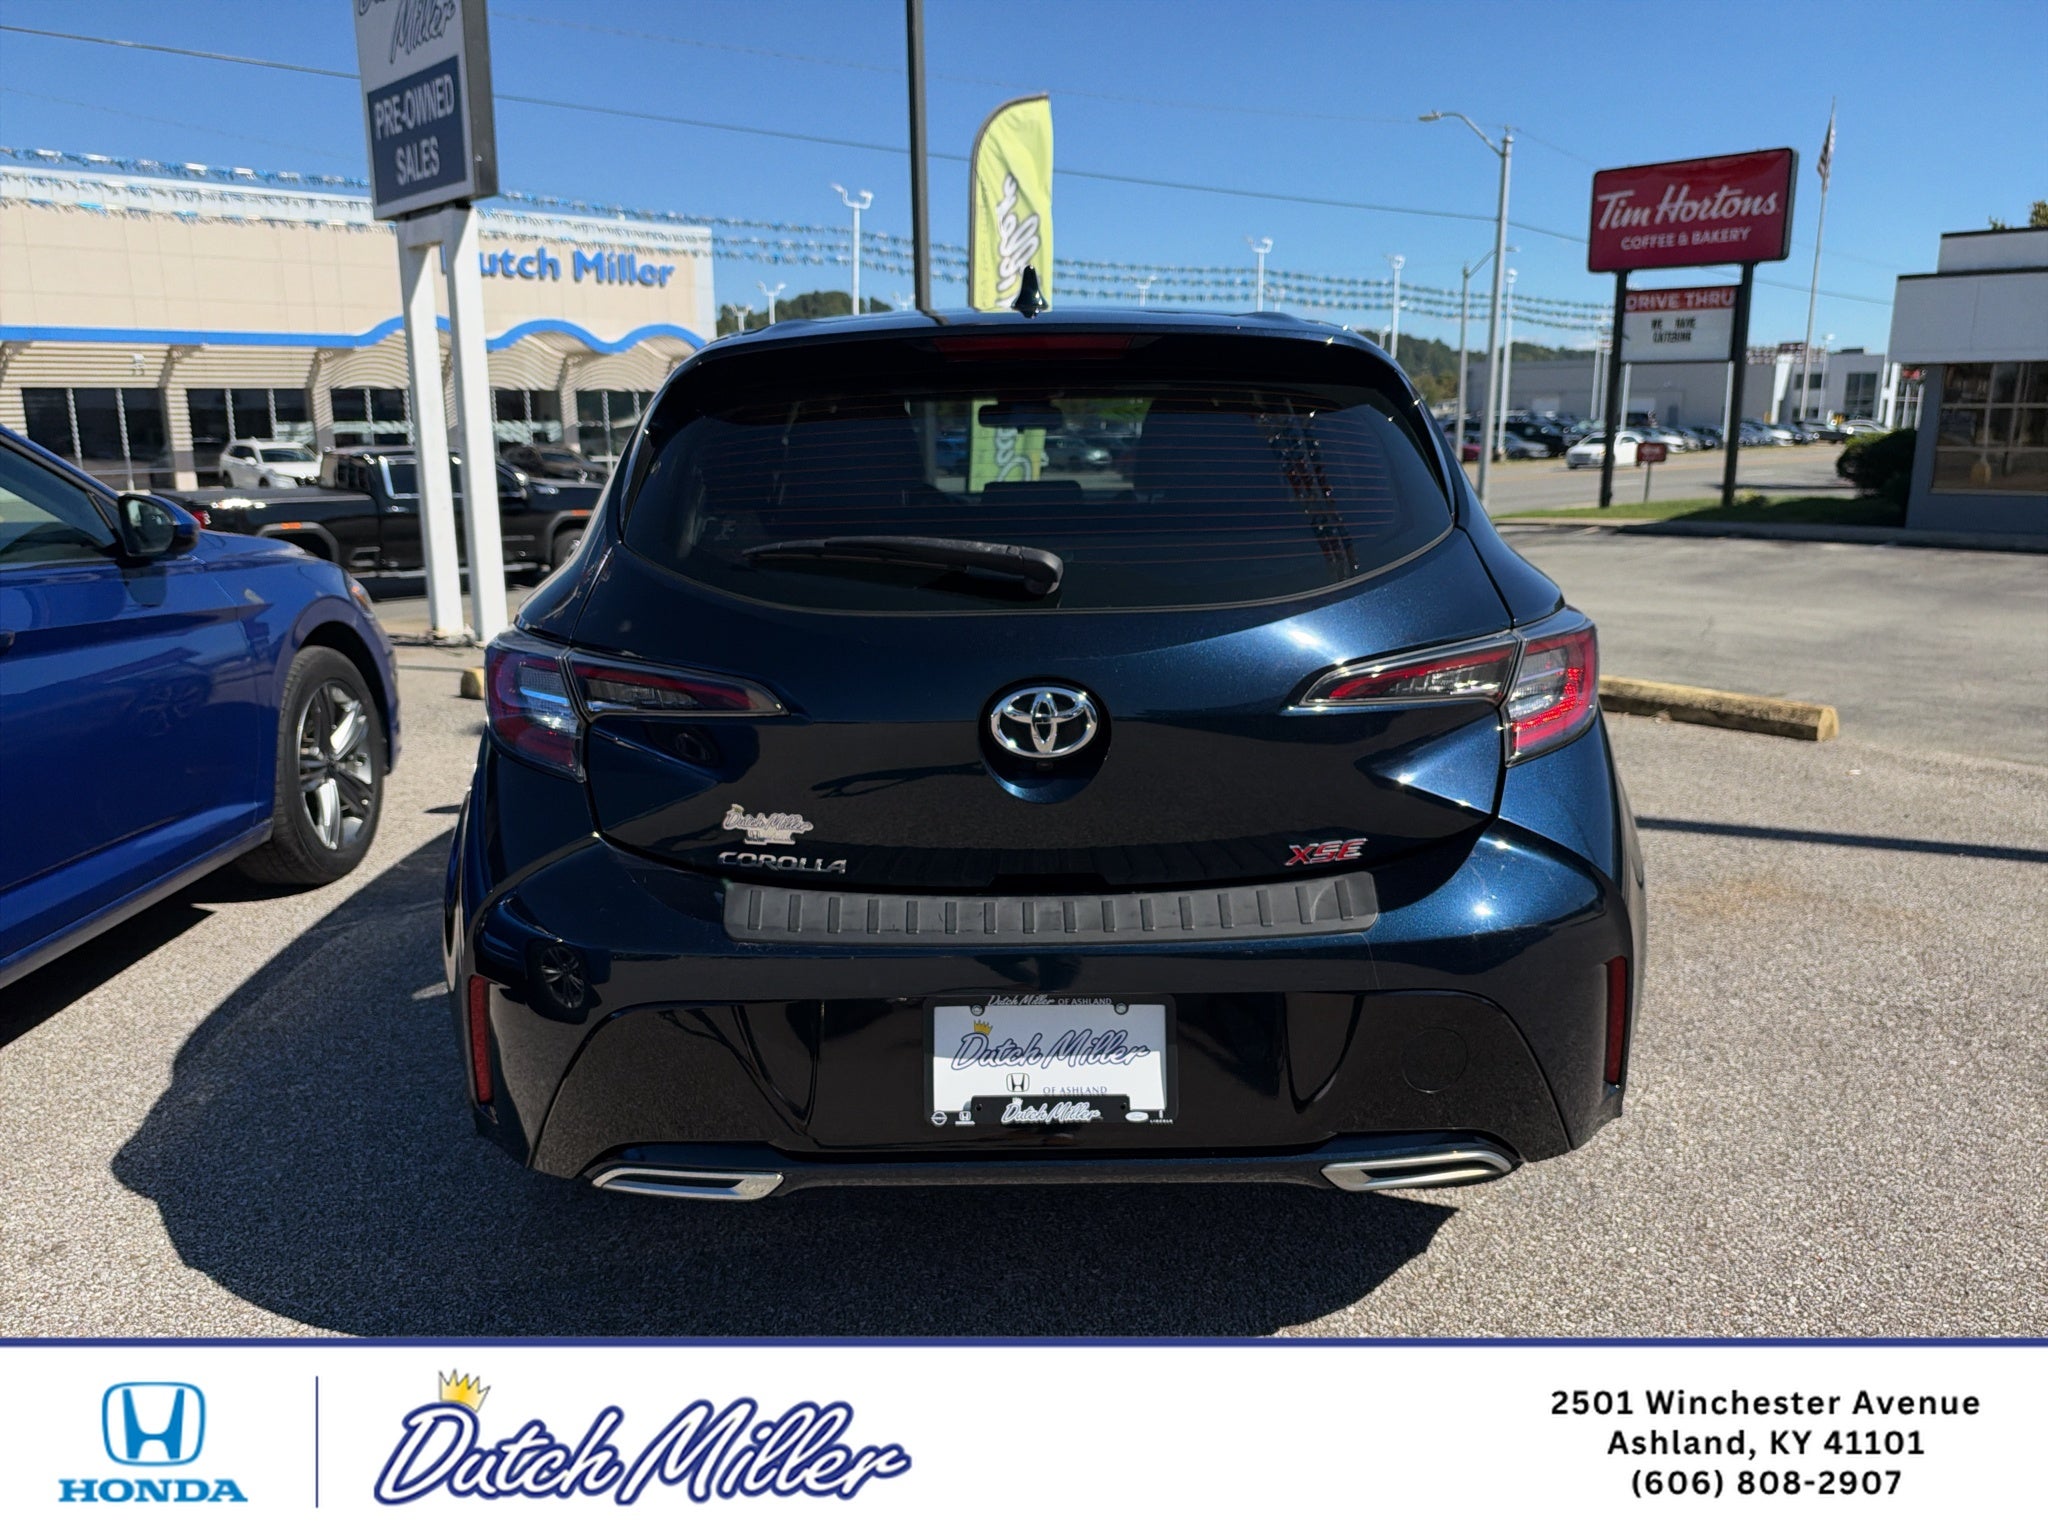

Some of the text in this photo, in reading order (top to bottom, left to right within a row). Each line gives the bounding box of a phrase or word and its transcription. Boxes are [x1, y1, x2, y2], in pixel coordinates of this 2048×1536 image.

[373, 73, 456, 140] PRE-OWNED
[395, 135, 441, 186] SALES
[1597, 184, 1779, 230] Tim Hortons
[1620, 226, 1752, 250] COFFEE & BAKERY
[441, 245, 676, 287] utch Miller
[1625, 289, 1736, 311] DRIVE THRU
[725, 811, 812, 833] Dutch Miller
[718, 851, 848, 875] COROLLA
[1284, 837, 1369, 867] XSE
[987, 993, 1112, 1006] Dutch Miller OF ASHLAND
[951, 1028, 1151, 1070] Dutch Miller
[1042, 1086, 1108, 1095] OF ASHLAND
[1001, 1101, 1101, 1125] Dutch Miller
